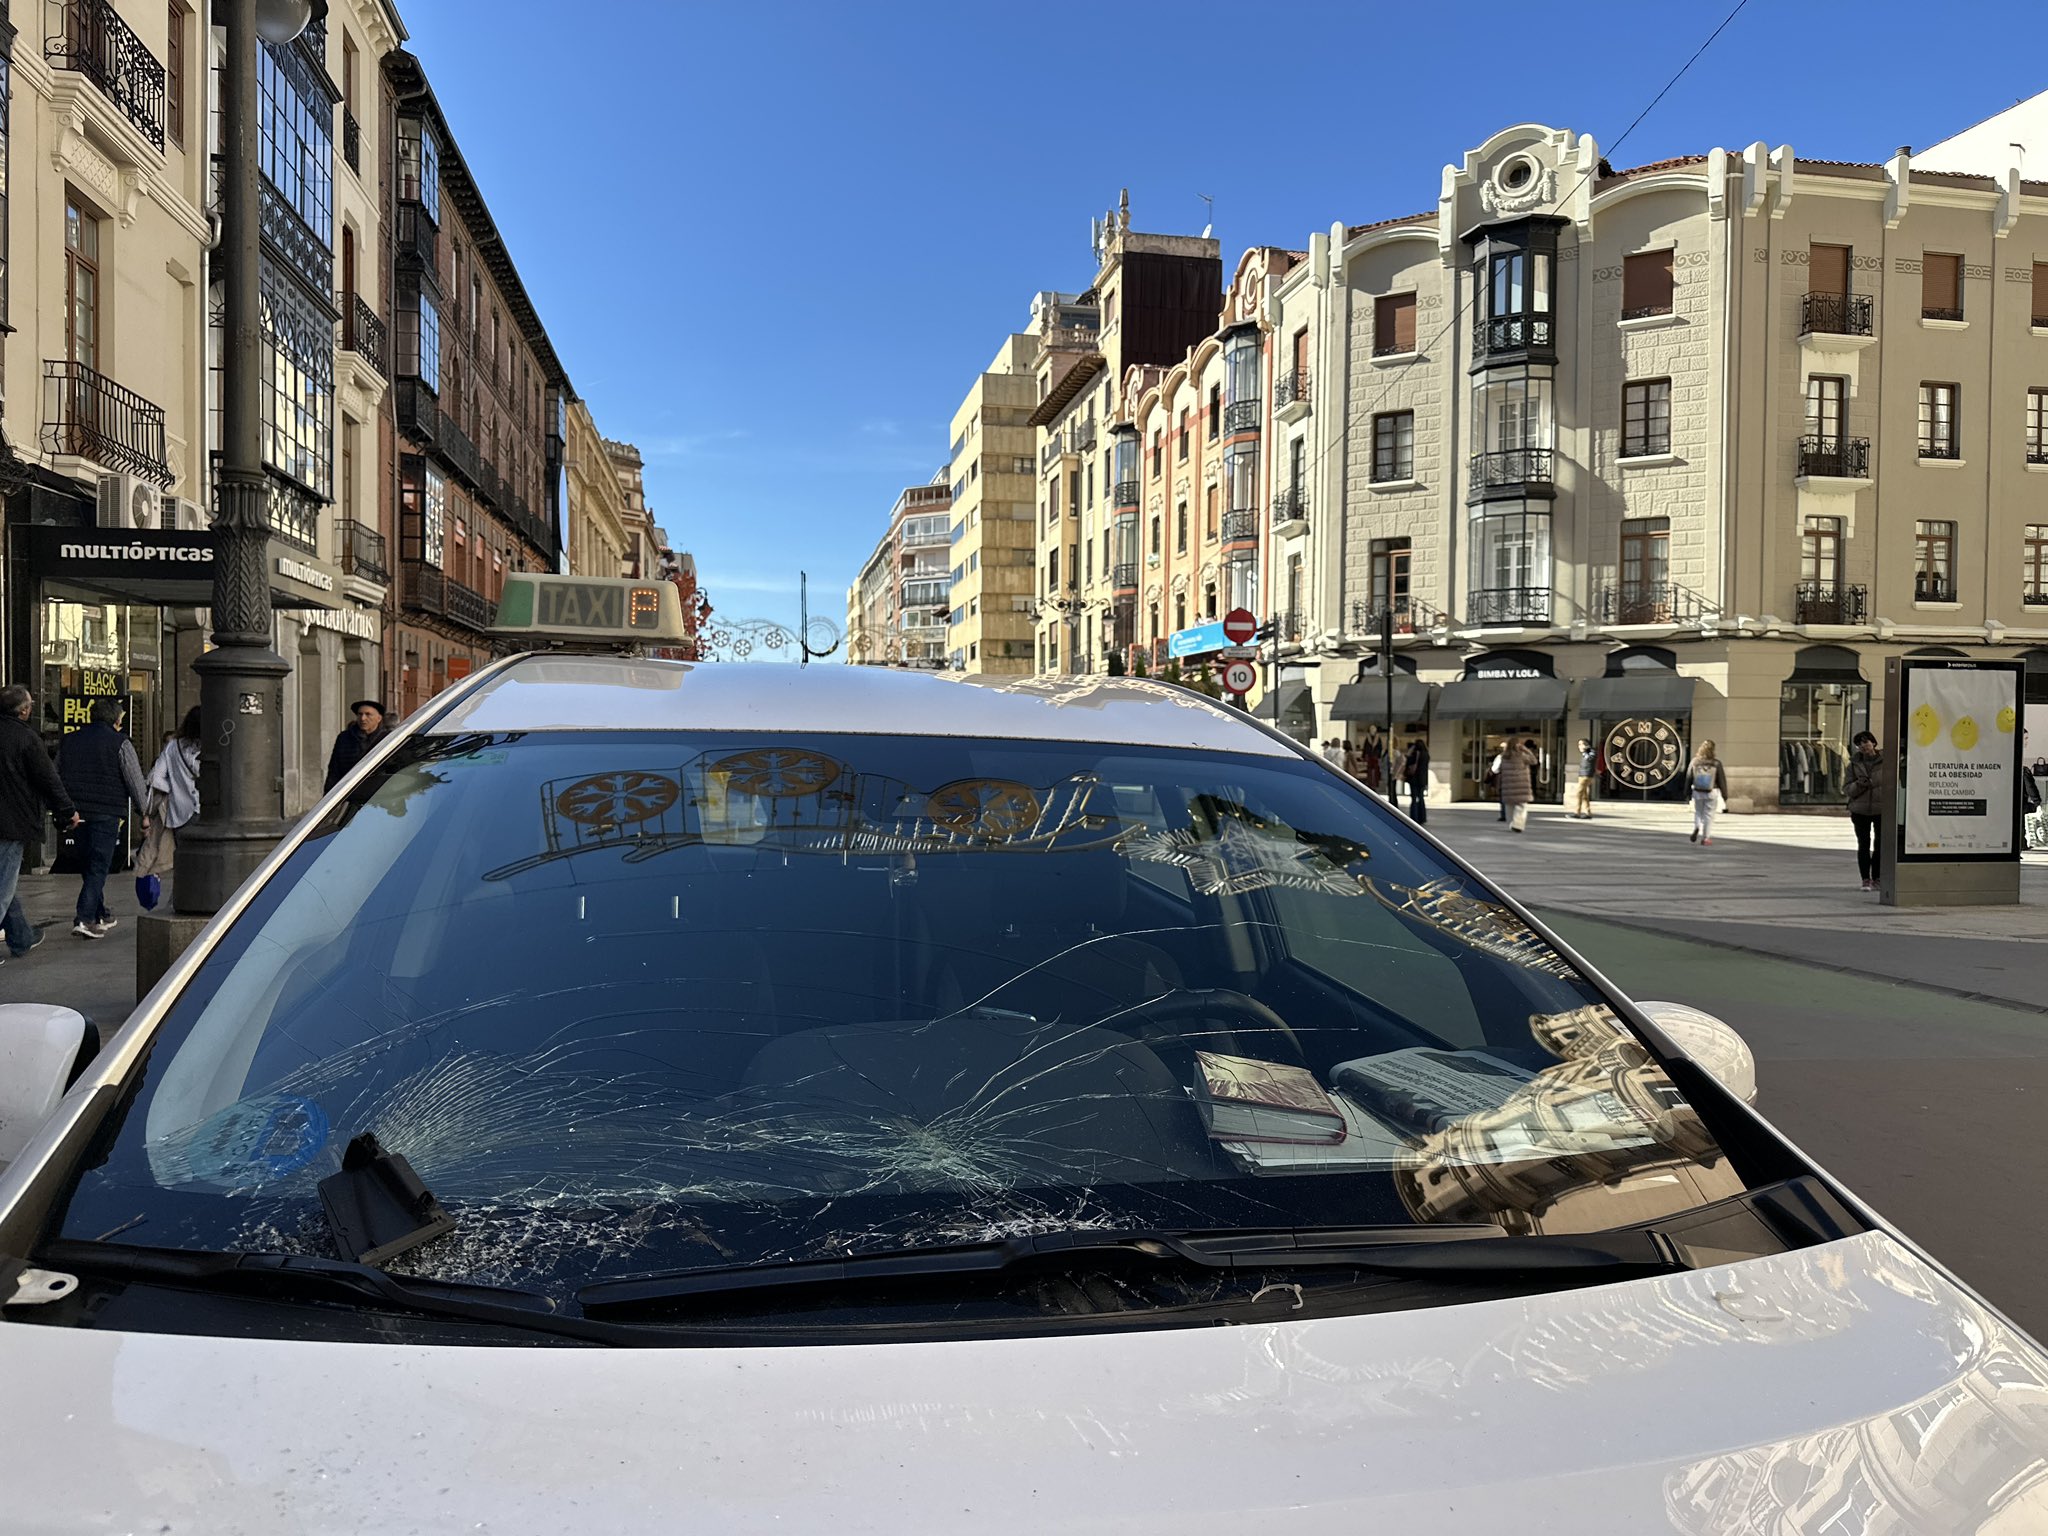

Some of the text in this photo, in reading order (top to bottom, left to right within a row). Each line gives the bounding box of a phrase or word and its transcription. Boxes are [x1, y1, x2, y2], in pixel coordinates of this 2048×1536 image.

[543, 585, 658, 626] TAXI P
[83, 670, 116, 690] BLACK
[1232, 671, 1247, 683] 10
[1477, 669, 1540, 679] BIMBA Y LOLA
[1928, 762, 1969, 770] LITERATURA
